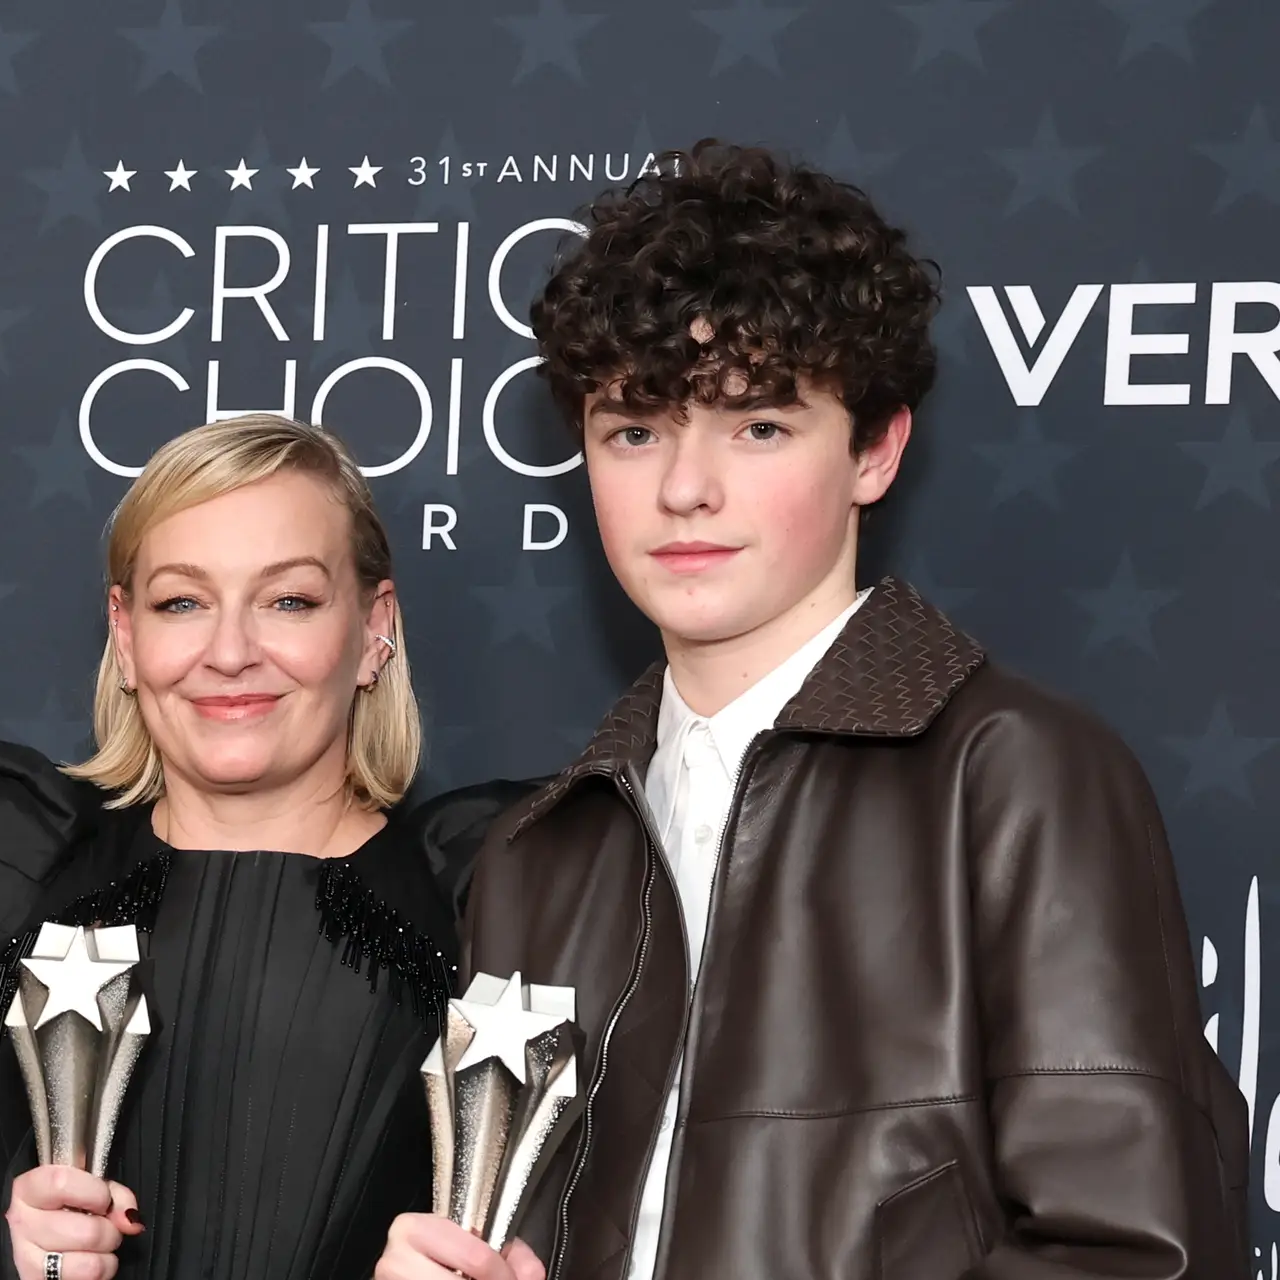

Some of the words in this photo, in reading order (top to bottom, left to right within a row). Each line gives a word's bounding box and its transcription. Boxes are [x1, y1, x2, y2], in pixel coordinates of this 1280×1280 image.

[408, 155, 488, 185] 31ST
[83, 217, 591, 345] CRITIC
[78, 356, 585, 478] CHOIC
